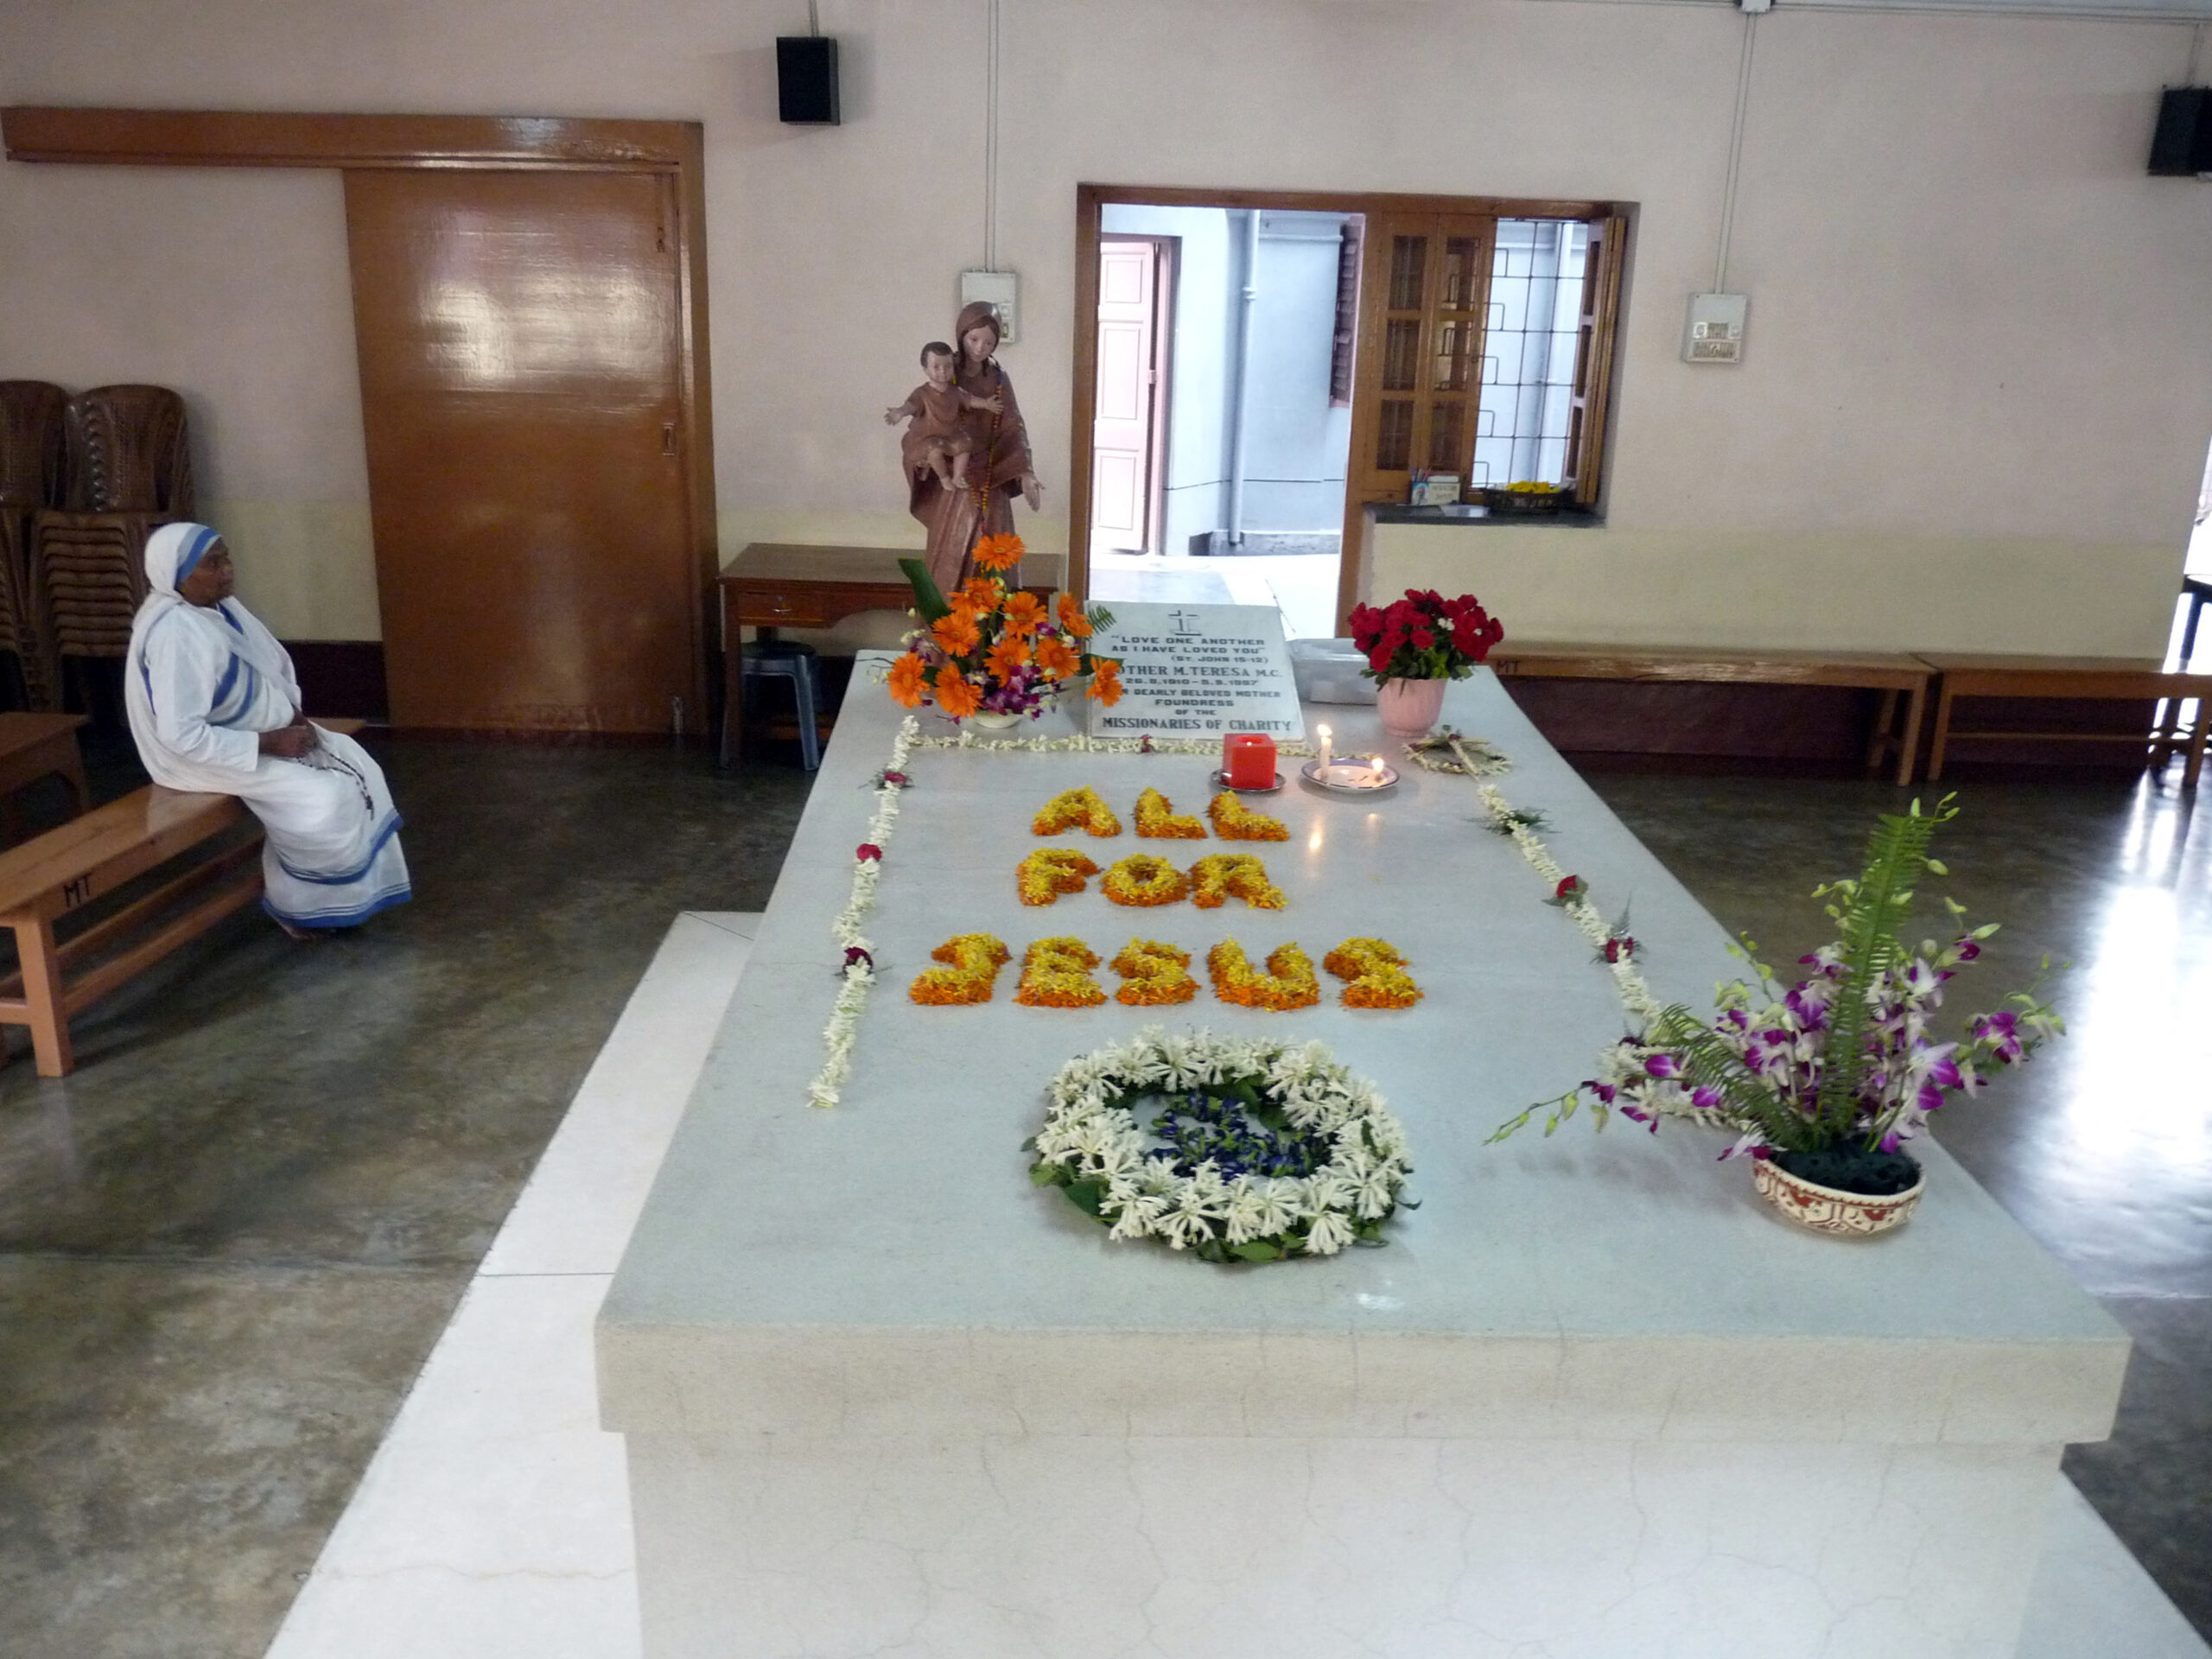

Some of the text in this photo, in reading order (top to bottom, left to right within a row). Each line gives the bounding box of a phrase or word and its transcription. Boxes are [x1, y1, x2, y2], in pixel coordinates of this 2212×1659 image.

[1255, 669, 1283, 677] M.C.
[1103, 717, 1292, 731] MISSIONARIES OF CHARITY
[1031, 785, 1290, 842] ALL
[62, 871, 93, 907] MT
[1016, 847, 1290, 911] FOR
[908, 932, 1424, 1013] JESUS
